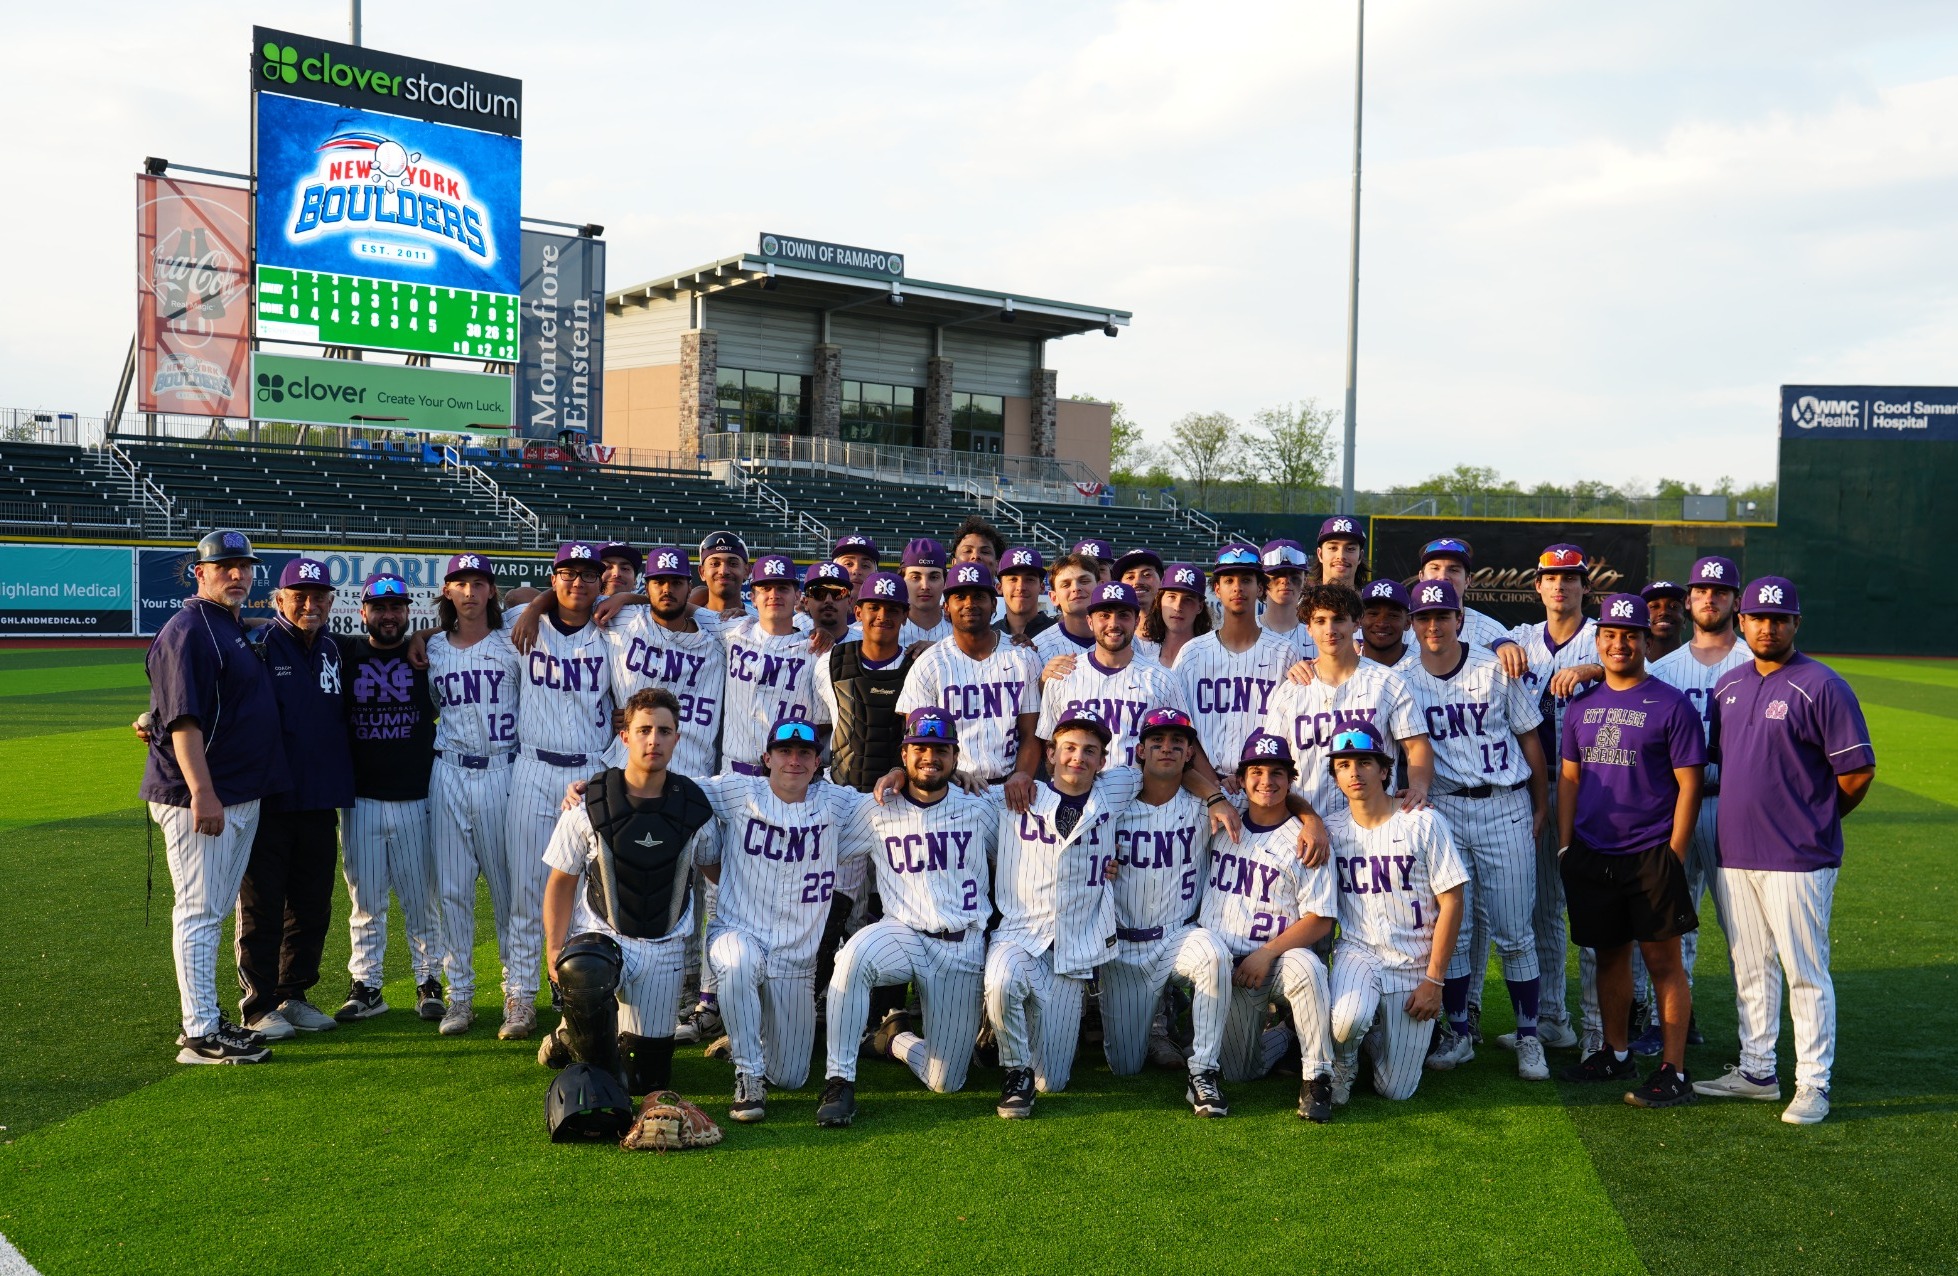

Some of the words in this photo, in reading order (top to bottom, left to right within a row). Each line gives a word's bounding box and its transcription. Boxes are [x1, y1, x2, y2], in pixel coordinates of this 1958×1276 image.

[302, 52, 402, 96] clover
[405, 73, 518, 119] stadium
[329, 160, 372, 181] NEW
[406, 166, 461, 200] YORK
[294, 183, 488, 258] BOULDERS
[362, 244, 390, 255] EST.
[397, 248, 427, 260] 2011
[781, 240, 816, 260] TOWN
[819, 246, 834, 262] OF
[837, 248, 886, 270] RAMAPO
[291, 285, 298, 299] 1
[312, 287, 319, 302] 1
[332, 289, 339, 304] 1
[351, 291, 359, 306] 0
[371, 294, 380, 308] 3
[392, 296, 398, 310] 1
[470, 305, 478, 319] 7
[488, 307, 497, 321] 9
[506, 309, 514, 323] 3
[260, 302, 284, 315] HOME
[290, 304, 299, 319] 0
[310, 306, 319, 321] 4
[330, 309, 340, 323] 4
[351, 311, 359, 325] 2
[390, 315, 399, 329] 3
[409, 317, 418, 331] 4
[428, 319, 437, 333] 5
[506, 327, 514, 341] 3
[531, 244, 559, 429] Montefiore
[166, 363, 184, 372] NEW
[197, 364, 220, 375] YORK
[563, 298, 590, 431] Einstein
[154, 372, 233, 397] BOULDERS
[288, 375, 367, 404] clover
[377, 392, 415, 406] Create
[418, 395, 445, 409] Your
[447, 397, 473, 410] Own
[476, 399, 505, 413] Luck.
[1814, 415, 1860, 428] Health
[1815, 400, 1860, 415] WMC
[1872, 415, 1928, 431] Hospital
[1873, 401, 1912, 415] Good
[1913, 401, 1958, 415] Samar
[0, 582, 59, 599] ighland
[63, 583, 121, 597] Medical
[141, 598, 168, 609] Your
[1465, 593, 1499, 602] STEAK,
[1500, 594, 1534, 603] CHOPS,
[529, 650, 604, 692] CCNY
[626, 637, 706, 687] CCNY
[729, 644, 806, 691] CCNY
[433, 669, 506, 707] CCNY
[943, 681, 1025, 721] CCNY
[1197, 676, 1277, 715] CCNY
[351, 711, 420, 726] ALUMNI
[487, 713, 516, 741] 12
[678, 693, 716, 727] 35
[1067, 698, 1148, 737] NY
[1425, 703, 1489, 741] CNY
[1583, 708, 1606, 724] CITY
[1606, 708, 1647, 728] COLLEGE
[356, 726, 412, 739] GAME
[1480, 741, 1509, 773] 17
[743, 818, 829, 862] CCNY
[885, 831, 972, 874] CCNY
[1115, 825, 1196, 869] CCNY
[801, 870, 836, 903] 22
[1182, 868, 1197, 901] 5
[1209, 850, 1280, 902] CCNY
[1336, 855, 1417, 894] CCNY
[961, 879, 978, 911] 2
[1249, 912, 1288, 942] 21
[1412, 901, 1424, 929] 1
